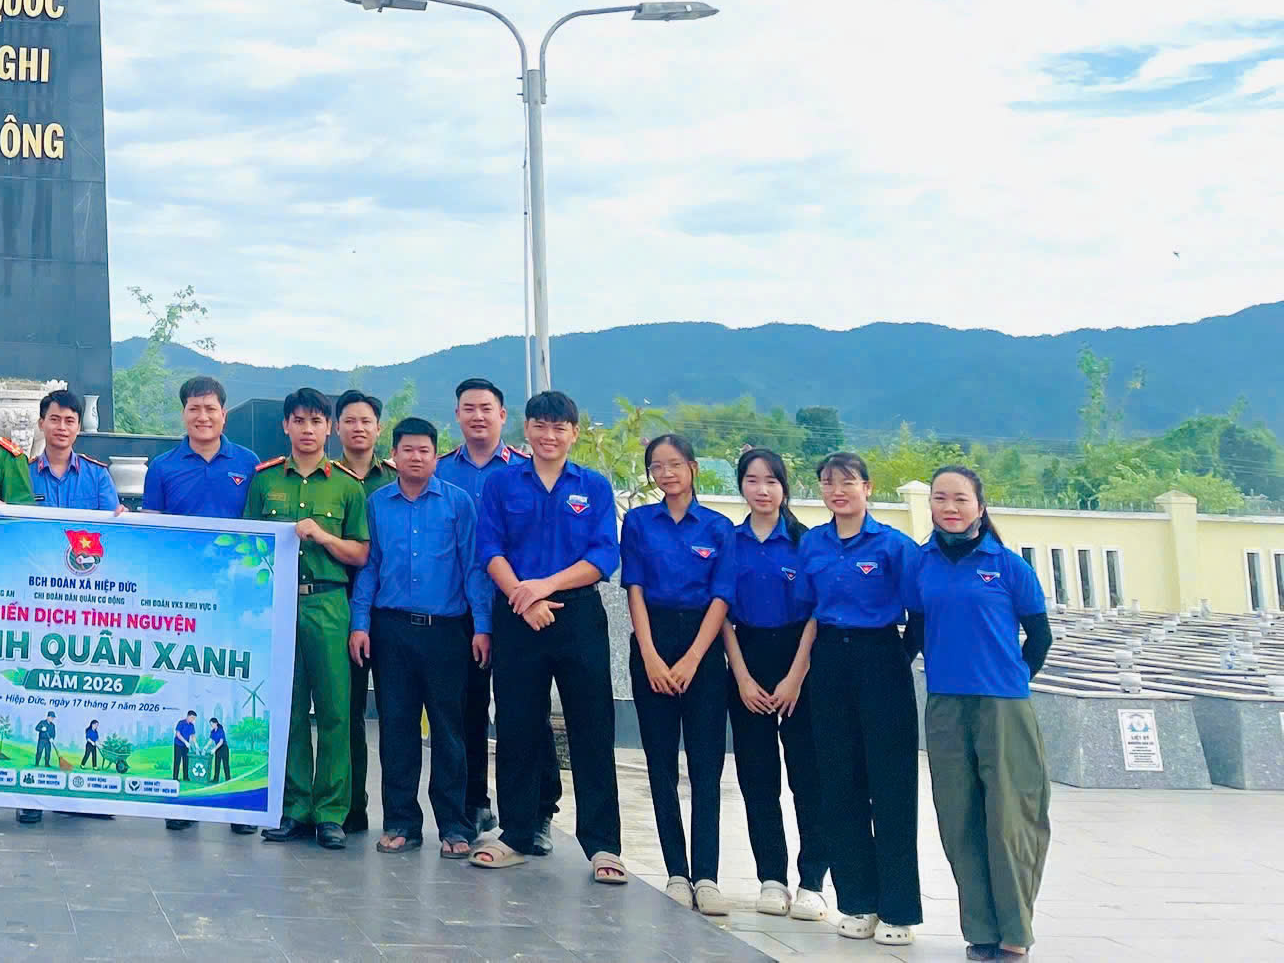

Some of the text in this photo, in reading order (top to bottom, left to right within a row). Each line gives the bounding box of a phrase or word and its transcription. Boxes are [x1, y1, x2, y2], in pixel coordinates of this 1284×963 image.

[28, 576, 137, 593] BCH ĐOÀN XÃ HIỆP ĐỨC
[34, 592, 45, 600] CHI
[140, 599, 151, 607] CHI
[34, 607, 76, 627] DỊCH
[81, 608, 122, 628] TÌNH
[126, 614, 196, 635] NGUYỆN
[40, 629, 142, 666] QUÂN
[152, 641, 251, 679] XANH
[38, 670, 124, 693] NĂM 2026
[5, 694, 160, 712] Hiệp Đức, ngày 17 tháng 7 năm 2026
